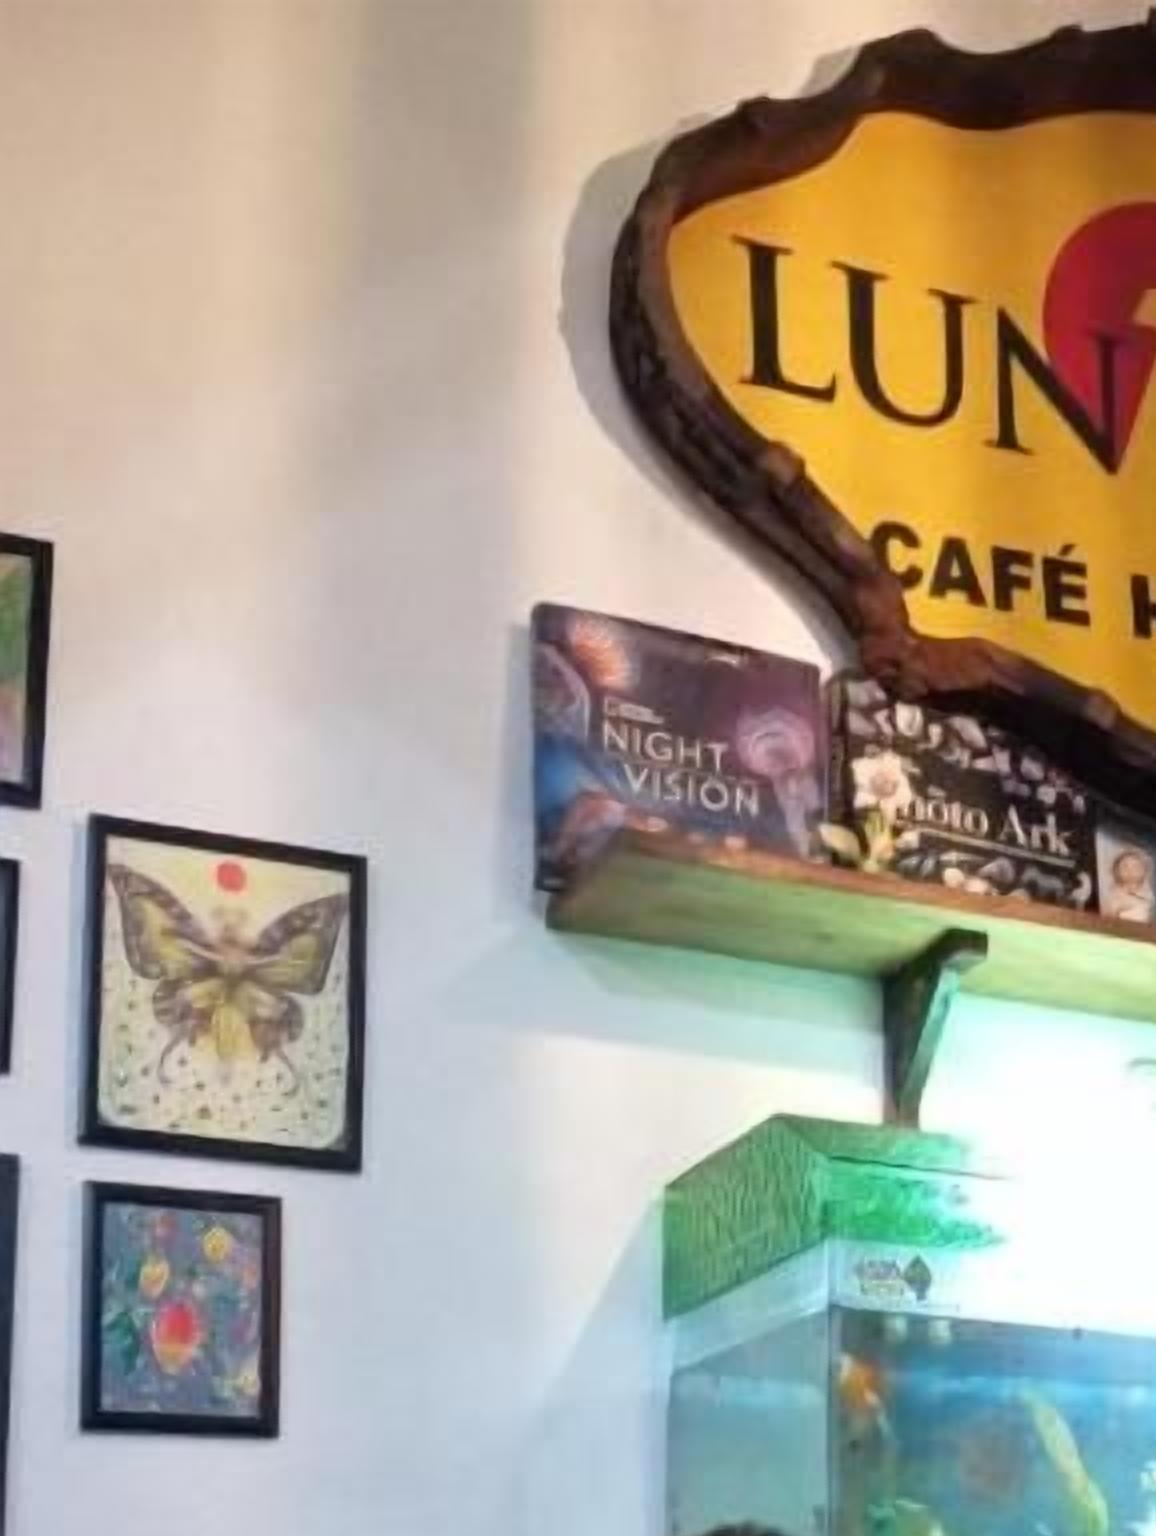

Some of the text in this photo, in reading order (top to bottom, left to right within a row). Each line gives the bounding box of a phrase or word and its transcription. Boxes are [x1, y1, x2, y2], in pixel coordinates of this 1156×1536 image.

[867, 519, 1092, 627] CAFÉ
[602, 718, 729, 772] NIGHT
[623, 763, 760, 817] VISION
[999, 803, 1075, 856] Ark
